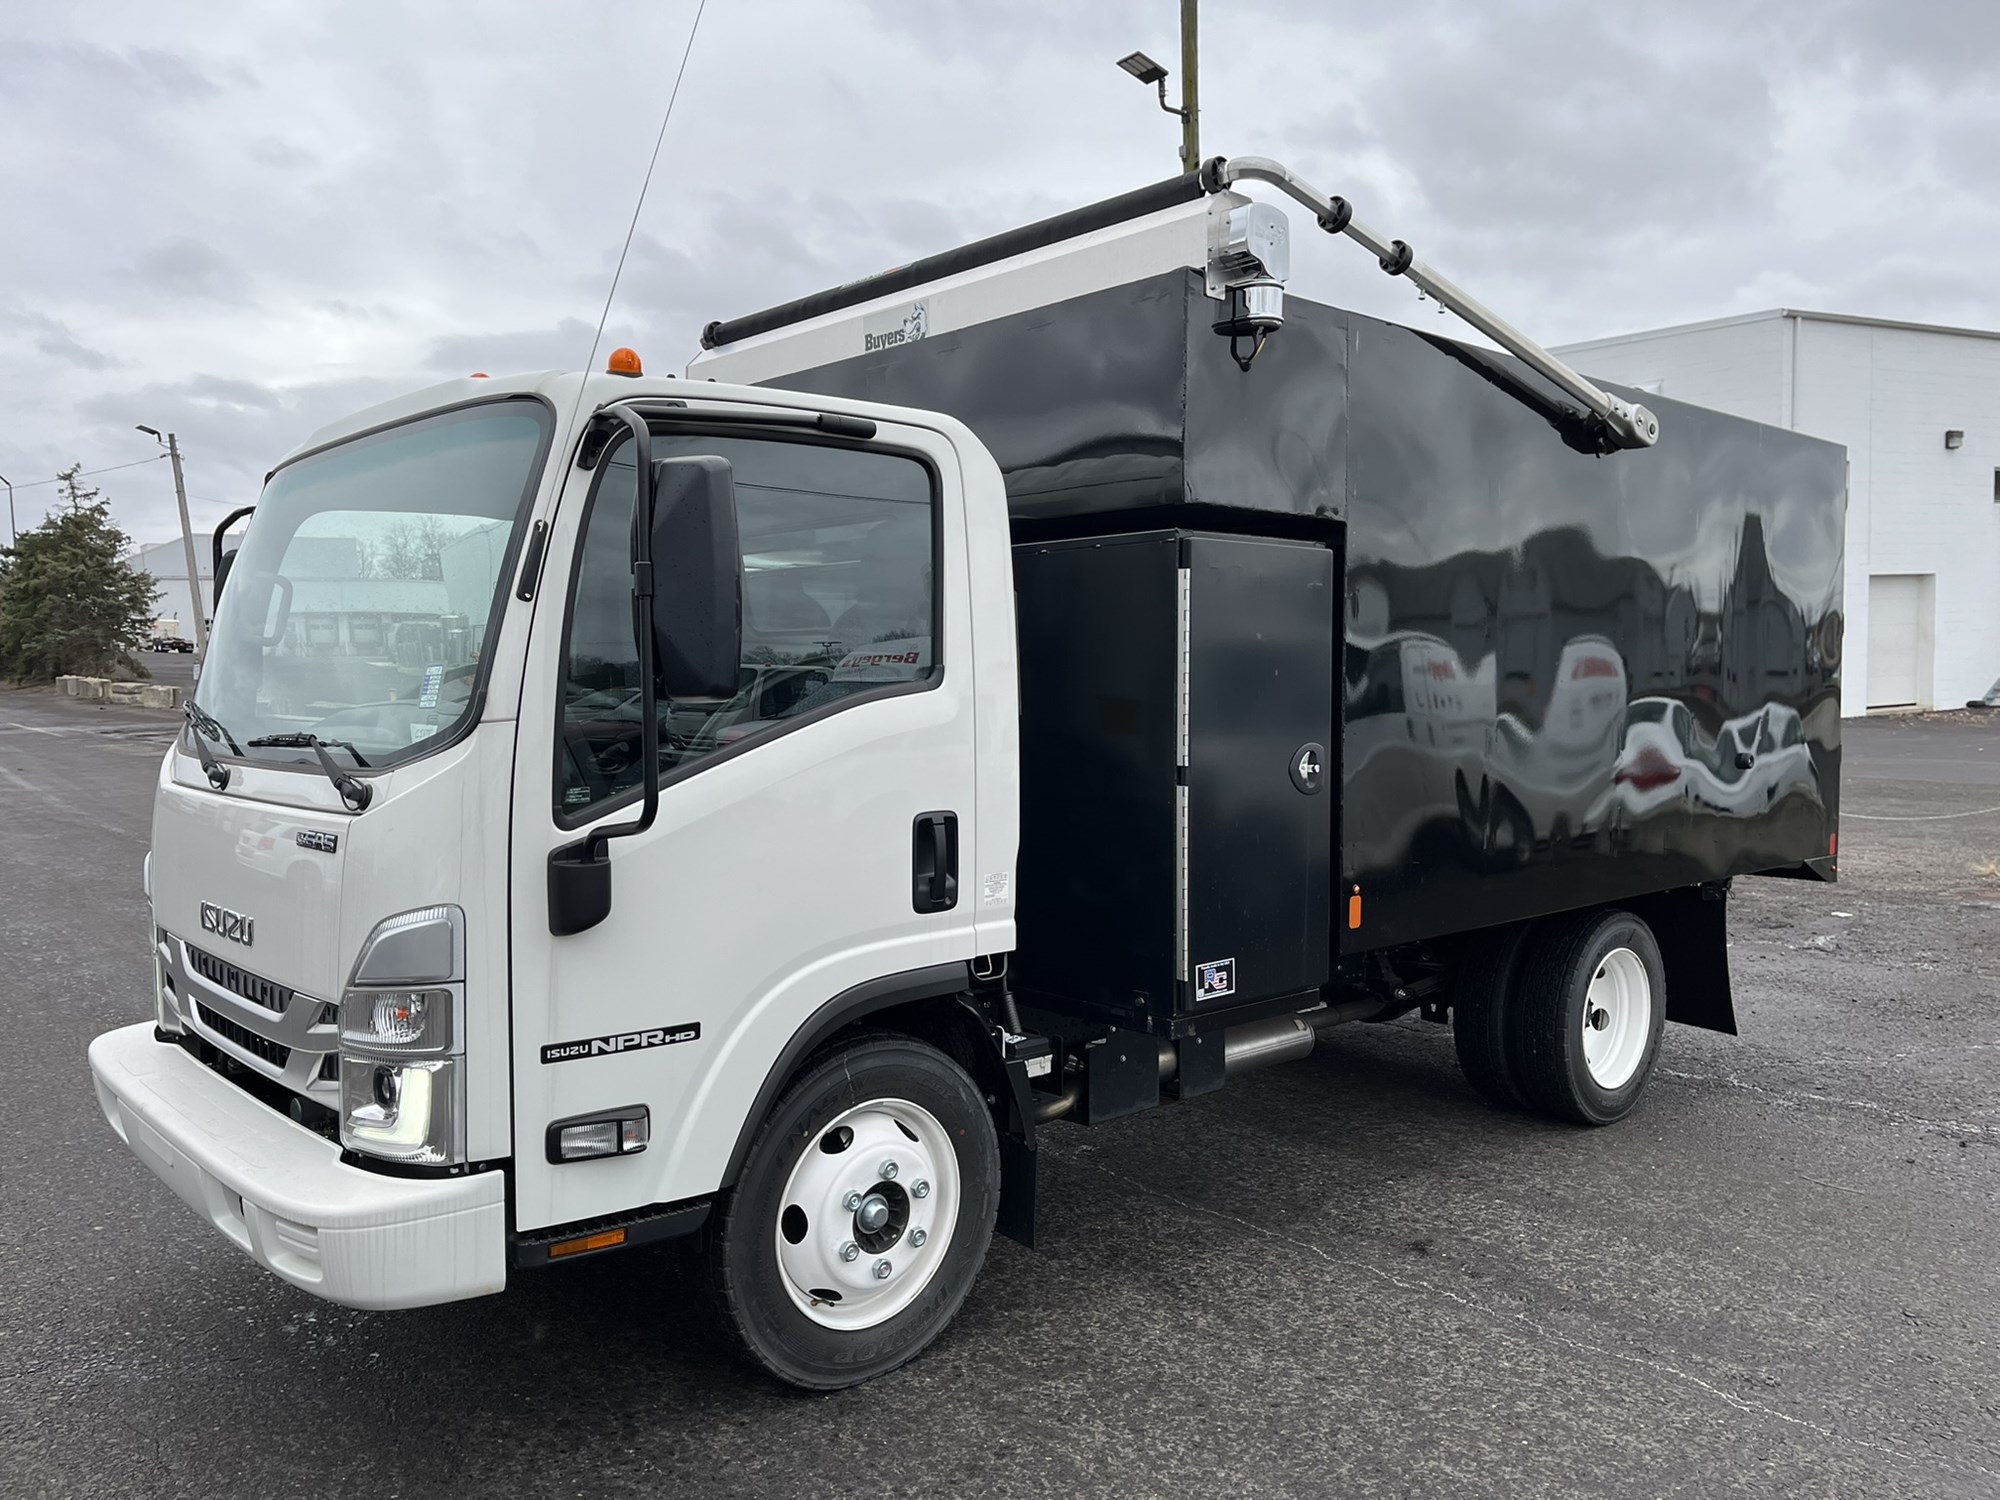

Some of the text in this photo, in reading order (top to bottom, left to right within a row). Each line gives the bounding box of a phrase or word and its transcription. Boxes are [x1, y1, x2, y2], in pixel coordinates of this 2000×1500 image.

[865, 328, 906, 351] Buyers
[201, 900, 254, 947] ISUZU
[546, 1044, 589, 1059] ISUZU
